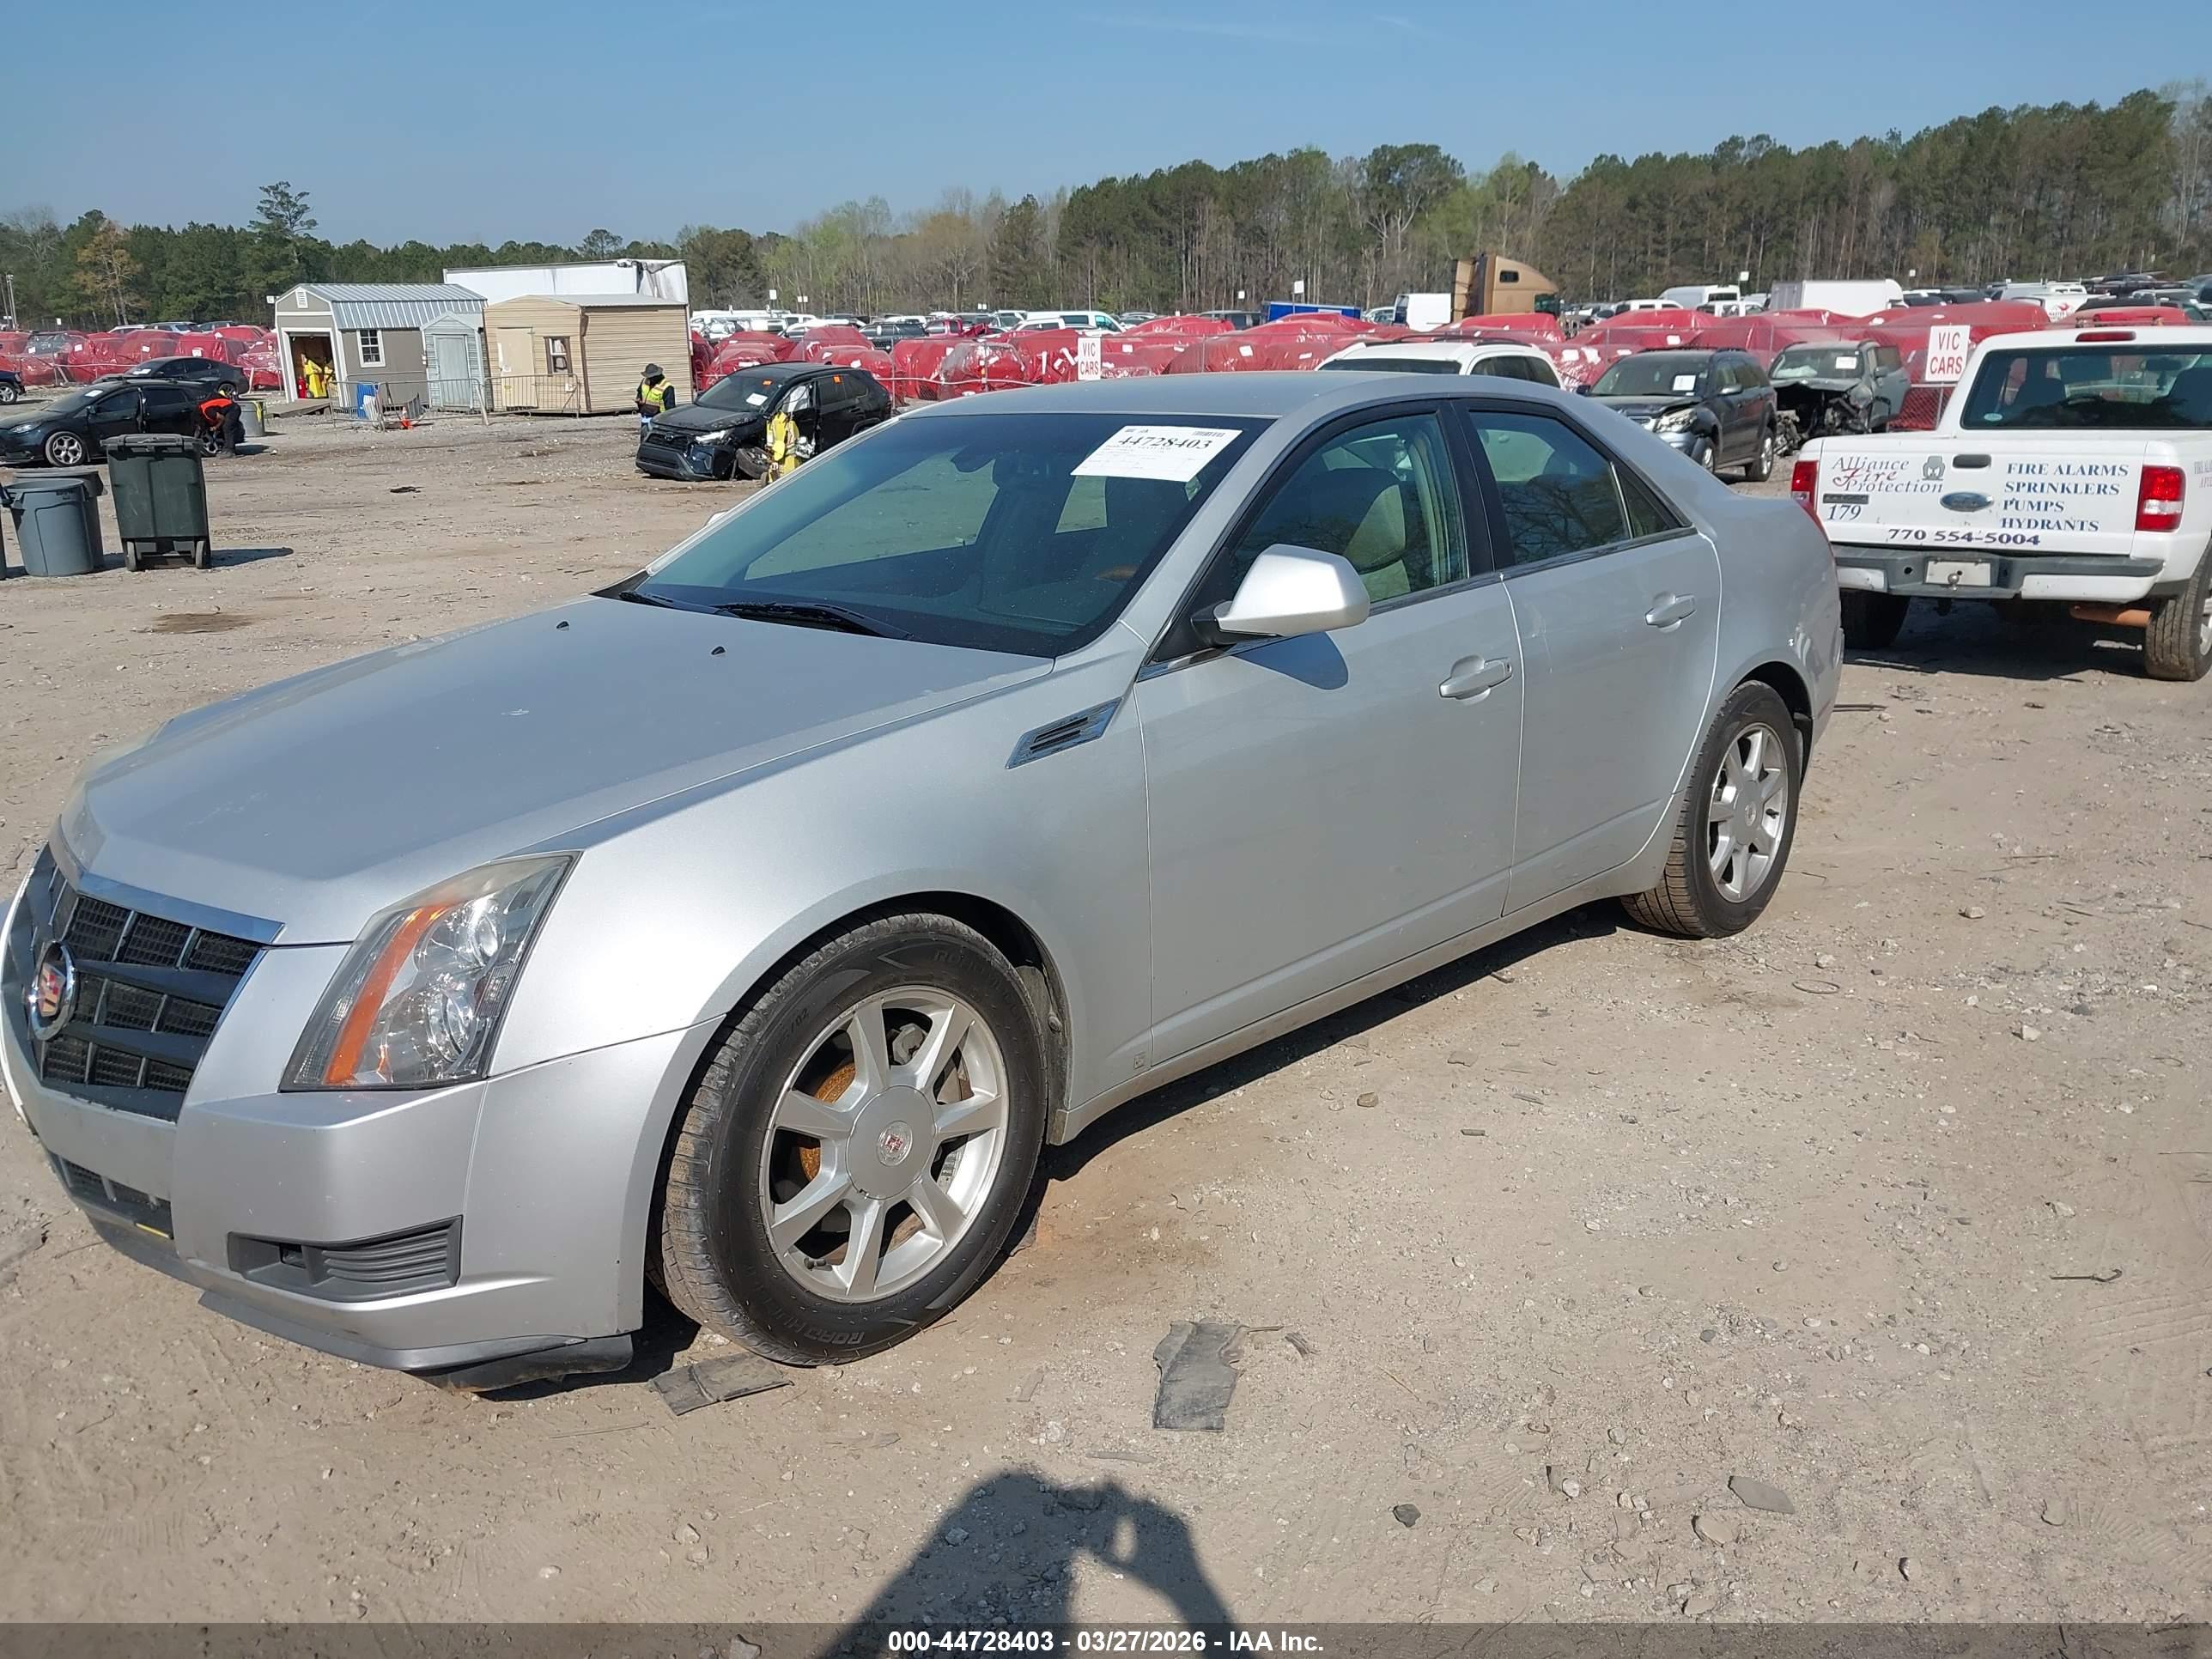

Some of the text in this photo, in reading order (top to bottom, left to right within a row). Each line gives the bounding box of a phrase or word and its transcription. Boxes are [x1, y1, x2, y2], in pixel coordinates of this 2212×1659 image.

[1938, 331, 1960, 350] VIC
[1082, 342, 1096, 357] VIC
[1079, 361, 1099, 376] CARS
[1929, 356, 1963, 374] CARS
[1118, 435, 1212, 450] 44728403
[1832, 456, 1910, 472] Alliance
[2007, 463, 2130, 477] FIRE ALARMS
[1832, 468, 1898, 487] Fire
[1844, 479, 1944, 493] Protection
[2004, 481, 2121, 495] SPRINKLERS
[1826, 504, 1863, 521] 179
[2002, 499, 2065, 512] PUMPS
[2001, 518, 2100, 532] HYDRANTS
[1888, 528, 2041, 546] 770 554-5004
